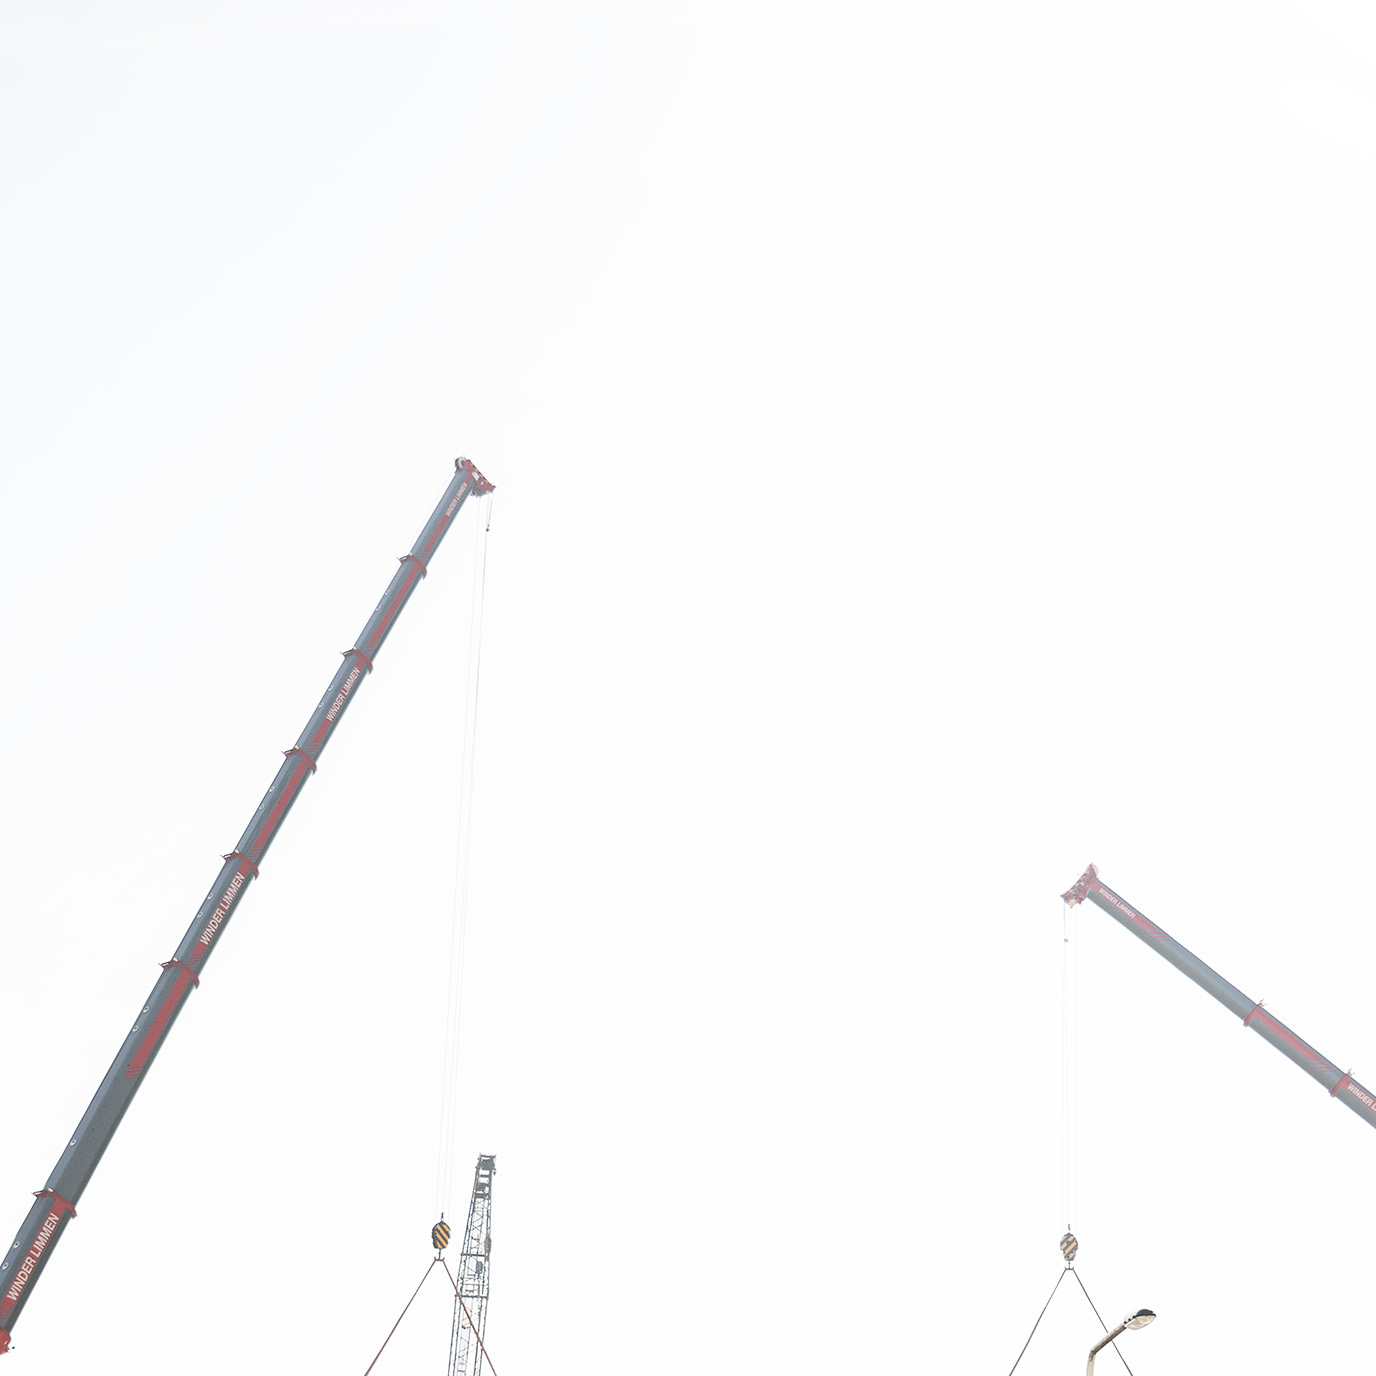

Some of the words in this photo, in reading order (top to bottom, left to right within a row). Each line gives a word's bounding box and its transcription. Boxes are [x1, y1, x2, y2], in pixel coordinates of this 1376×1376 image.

[325, 692, 347, 722] WINDER
[343, 667, 361, 696] LIMMEN
[199, 907, 225, 945] WINDER
[221, 872, 245, 910] LIMMEN
[1099, 887, 1118, 905] WINDER
[1116, 900, 1136, 918] LIMMEN
[1347, 1083, 1373, 1110] WINDER
[6, 1255, 36, 1301] WINDER
[30, 1212, 60, 1258] LIMMEN
